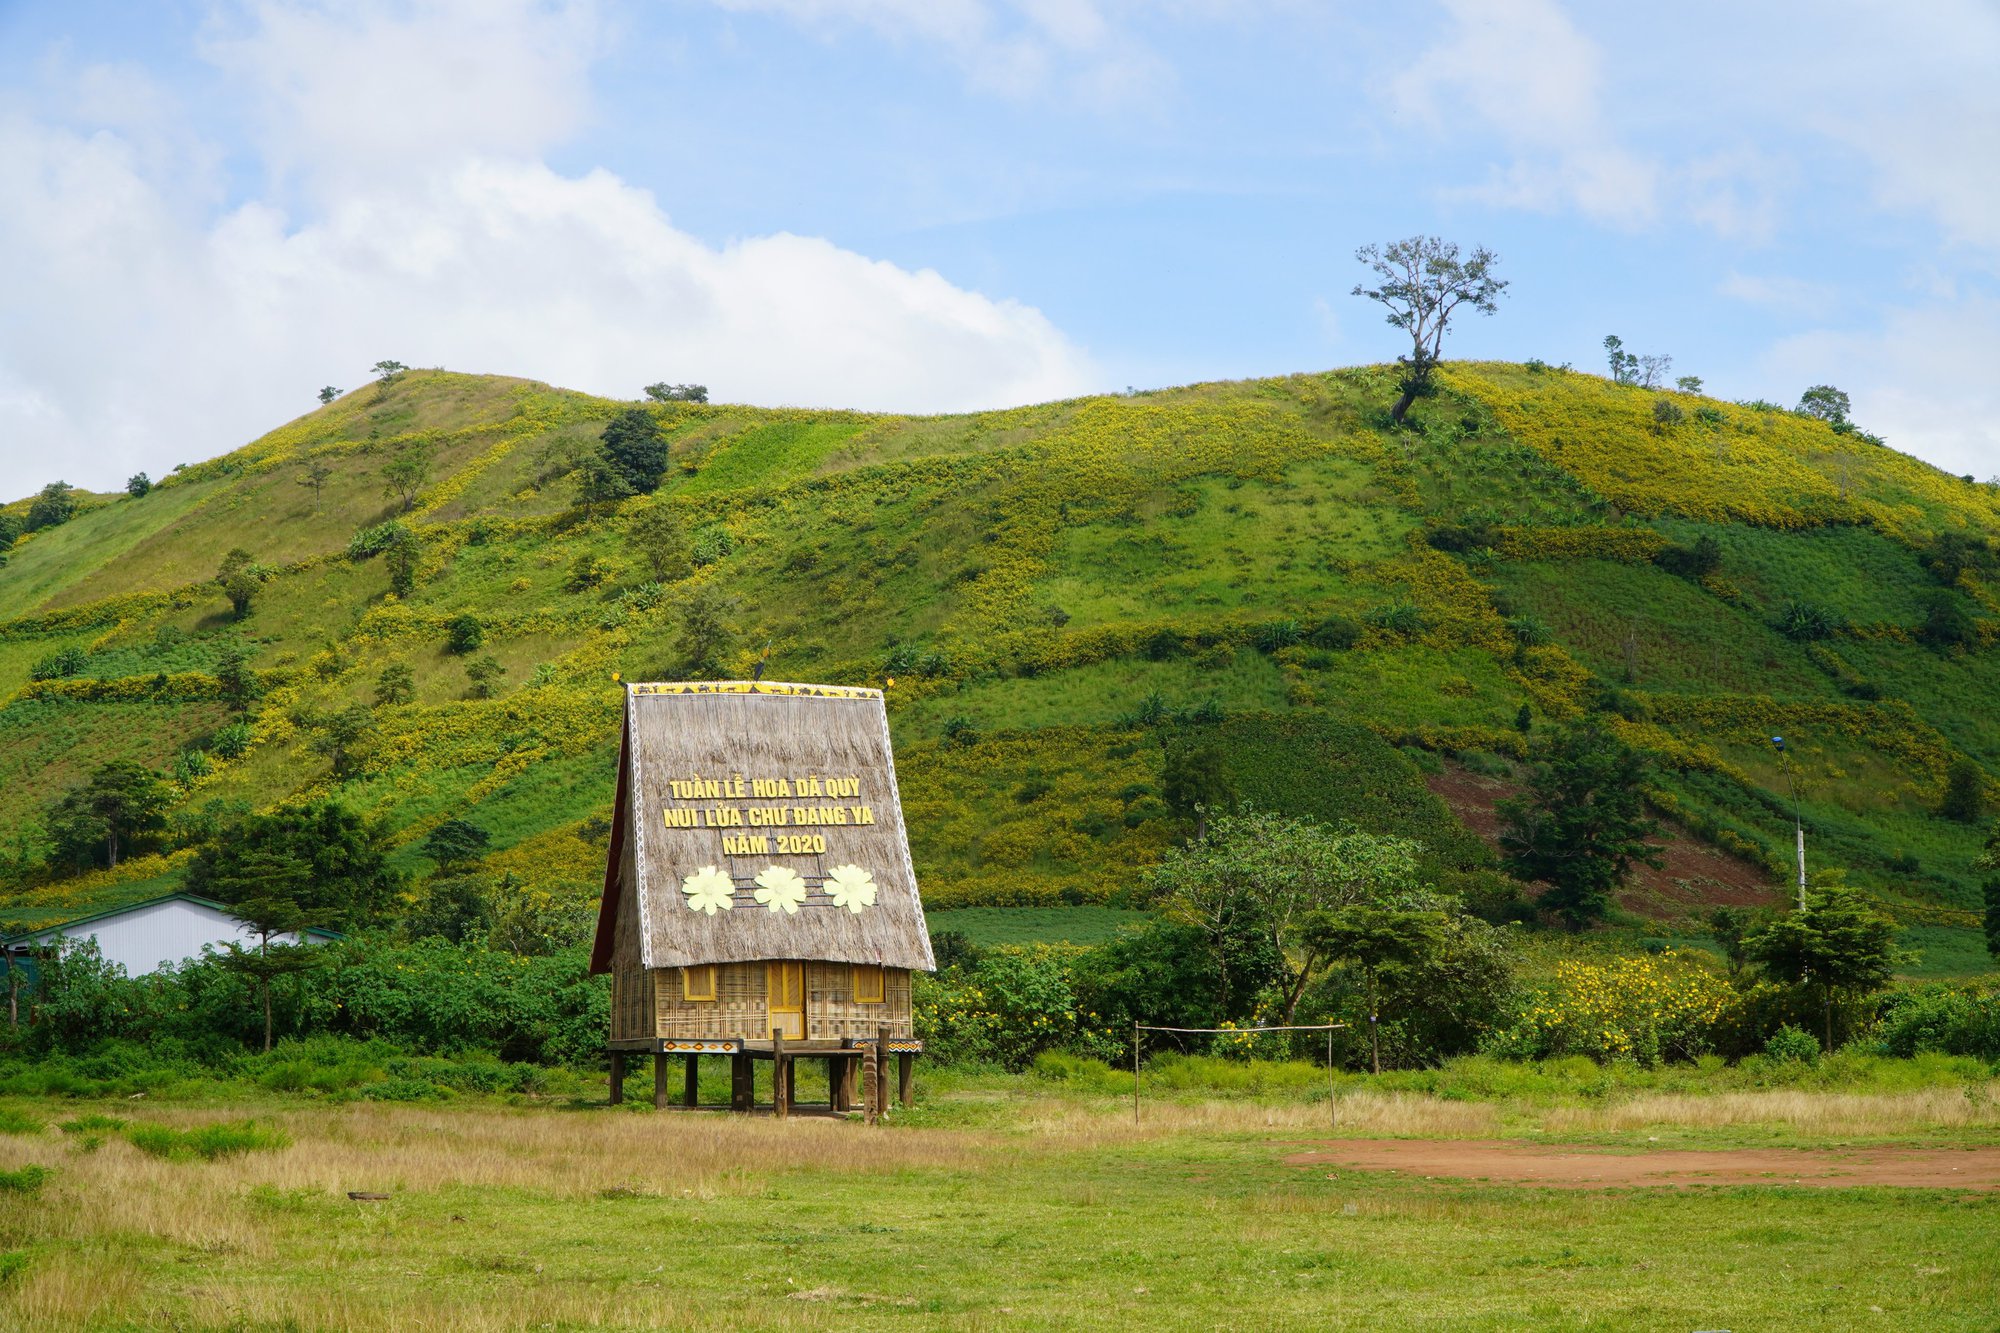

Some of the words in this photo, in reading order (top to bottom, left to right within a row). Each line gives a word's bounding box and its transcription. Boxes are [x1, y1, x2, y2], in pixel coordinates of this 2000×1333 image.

[669, 773, 721, 799] TUẦN
[724, 773, 747, 799] LỄ
[752, 777, 792, 798] HOA
[794, 775, 823, 798] DÃ
[825, 774, 861, 800] QUỲ
[663, 804, 699, 828] NÚI
[705, 802, 744, 827] LỬA
[748, 805, 788, 827] CHƯ
[793, 806, 847, 825] ĐANG
[850, 806, 875, 825] YA
[722, 832, 769, 855] NĂM
[776, 834, 826, 854] 2020
